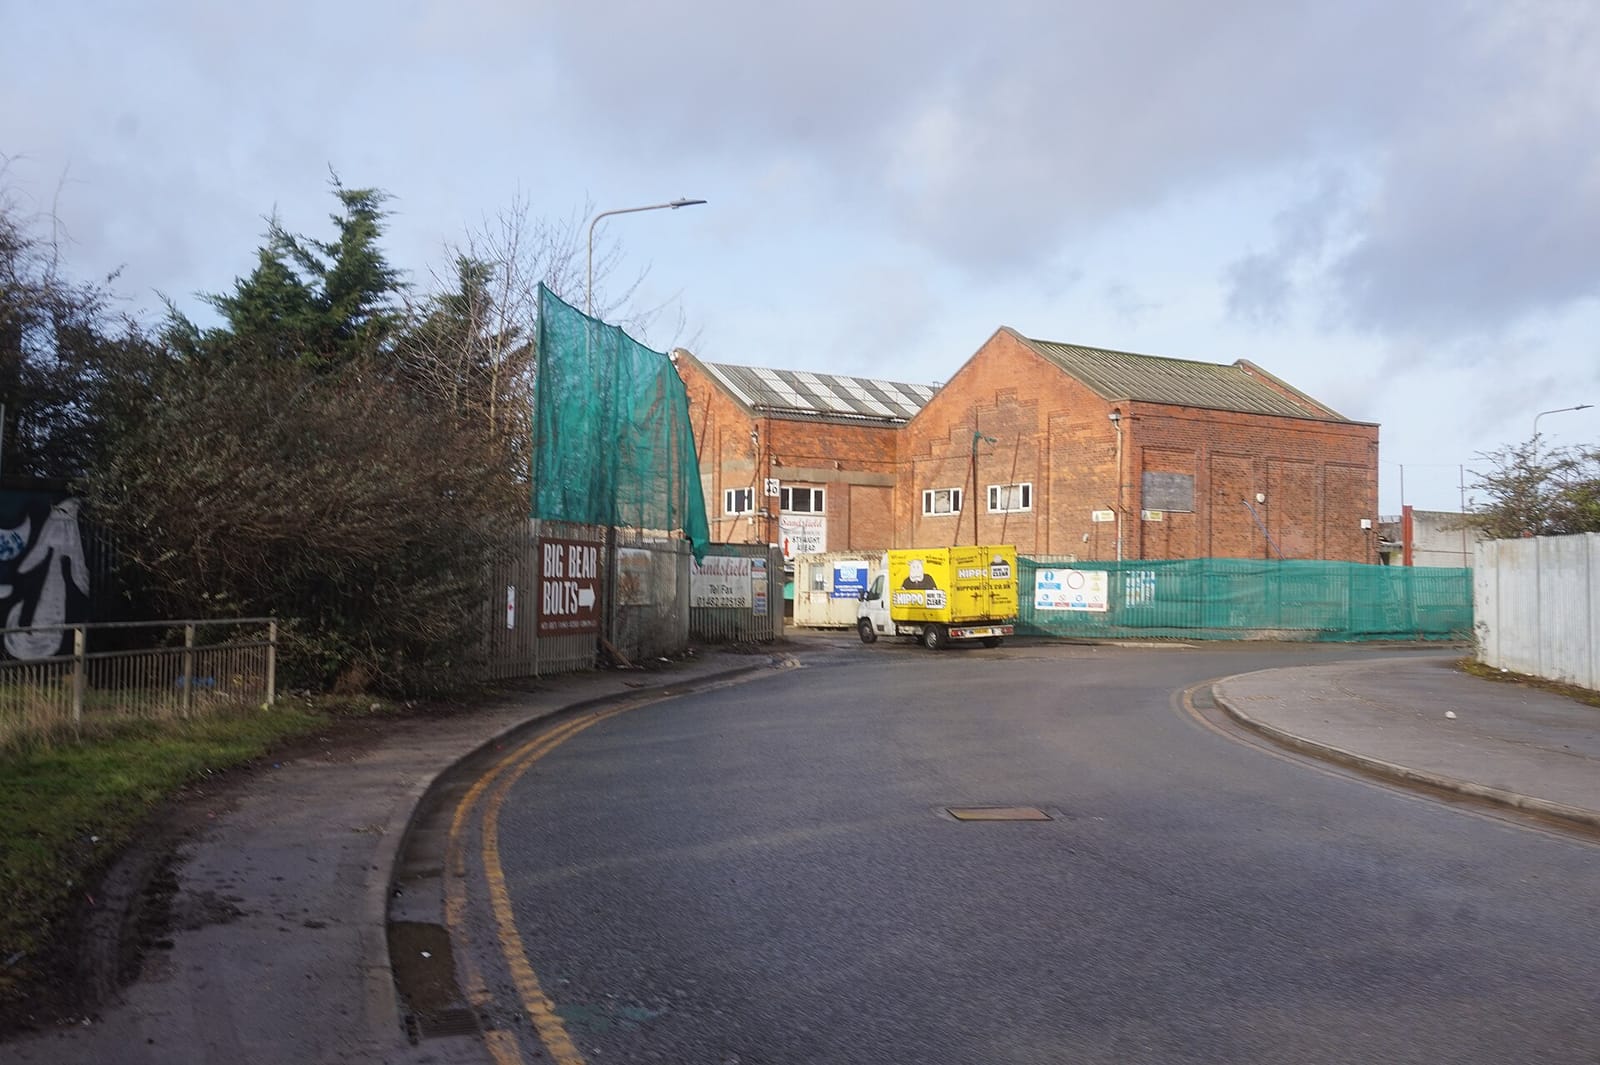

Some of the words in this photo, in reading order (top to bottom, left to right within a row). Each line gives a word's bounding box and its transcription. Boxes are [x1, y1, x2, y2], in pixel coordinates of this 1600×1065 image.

[543, 543, 564, 578] BIG
[568, 544, 597, 579] BEAR
[958, 568, 988, 578] HIPPO
[542, 580, 578, 616] BOLTS
[896, 592, 924, 606] HIPPO
